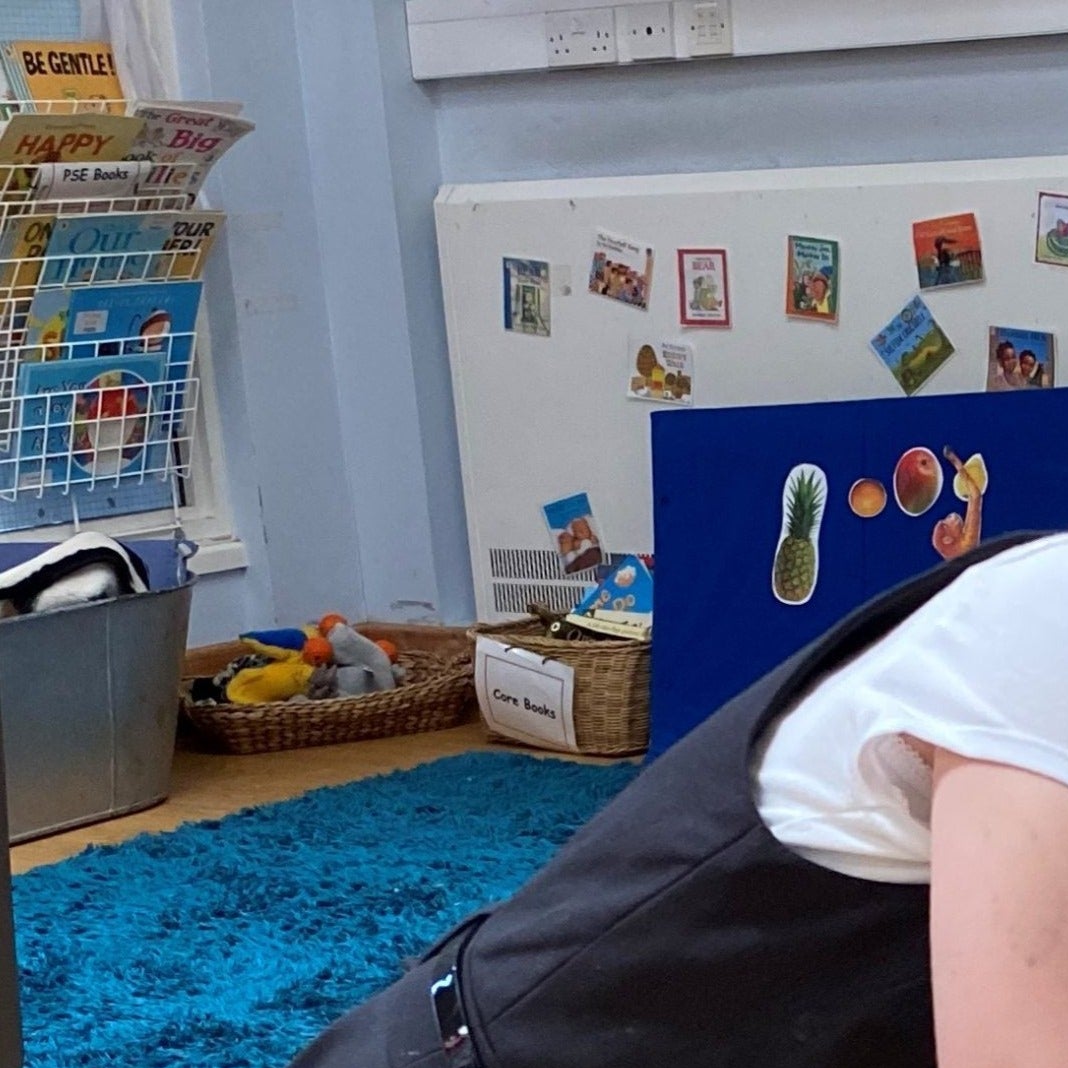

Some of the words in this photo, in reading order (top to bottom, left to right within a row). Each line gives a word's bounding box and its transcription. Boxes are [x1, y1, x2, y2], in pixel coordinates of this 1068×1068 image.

[22, 51, 48, 76] BE
[165, 111, 215, 127] Great
[14, 133, 115, 156] HAPPY
[167, 129, 222, 153] Big
[63, 168, 89, 182] PSE
[93, 167, 129, 181] Books
[68, 226, 142, 254] Our
[493, 689, 519, 706] Core
[523, 697, 557, 720] Books
